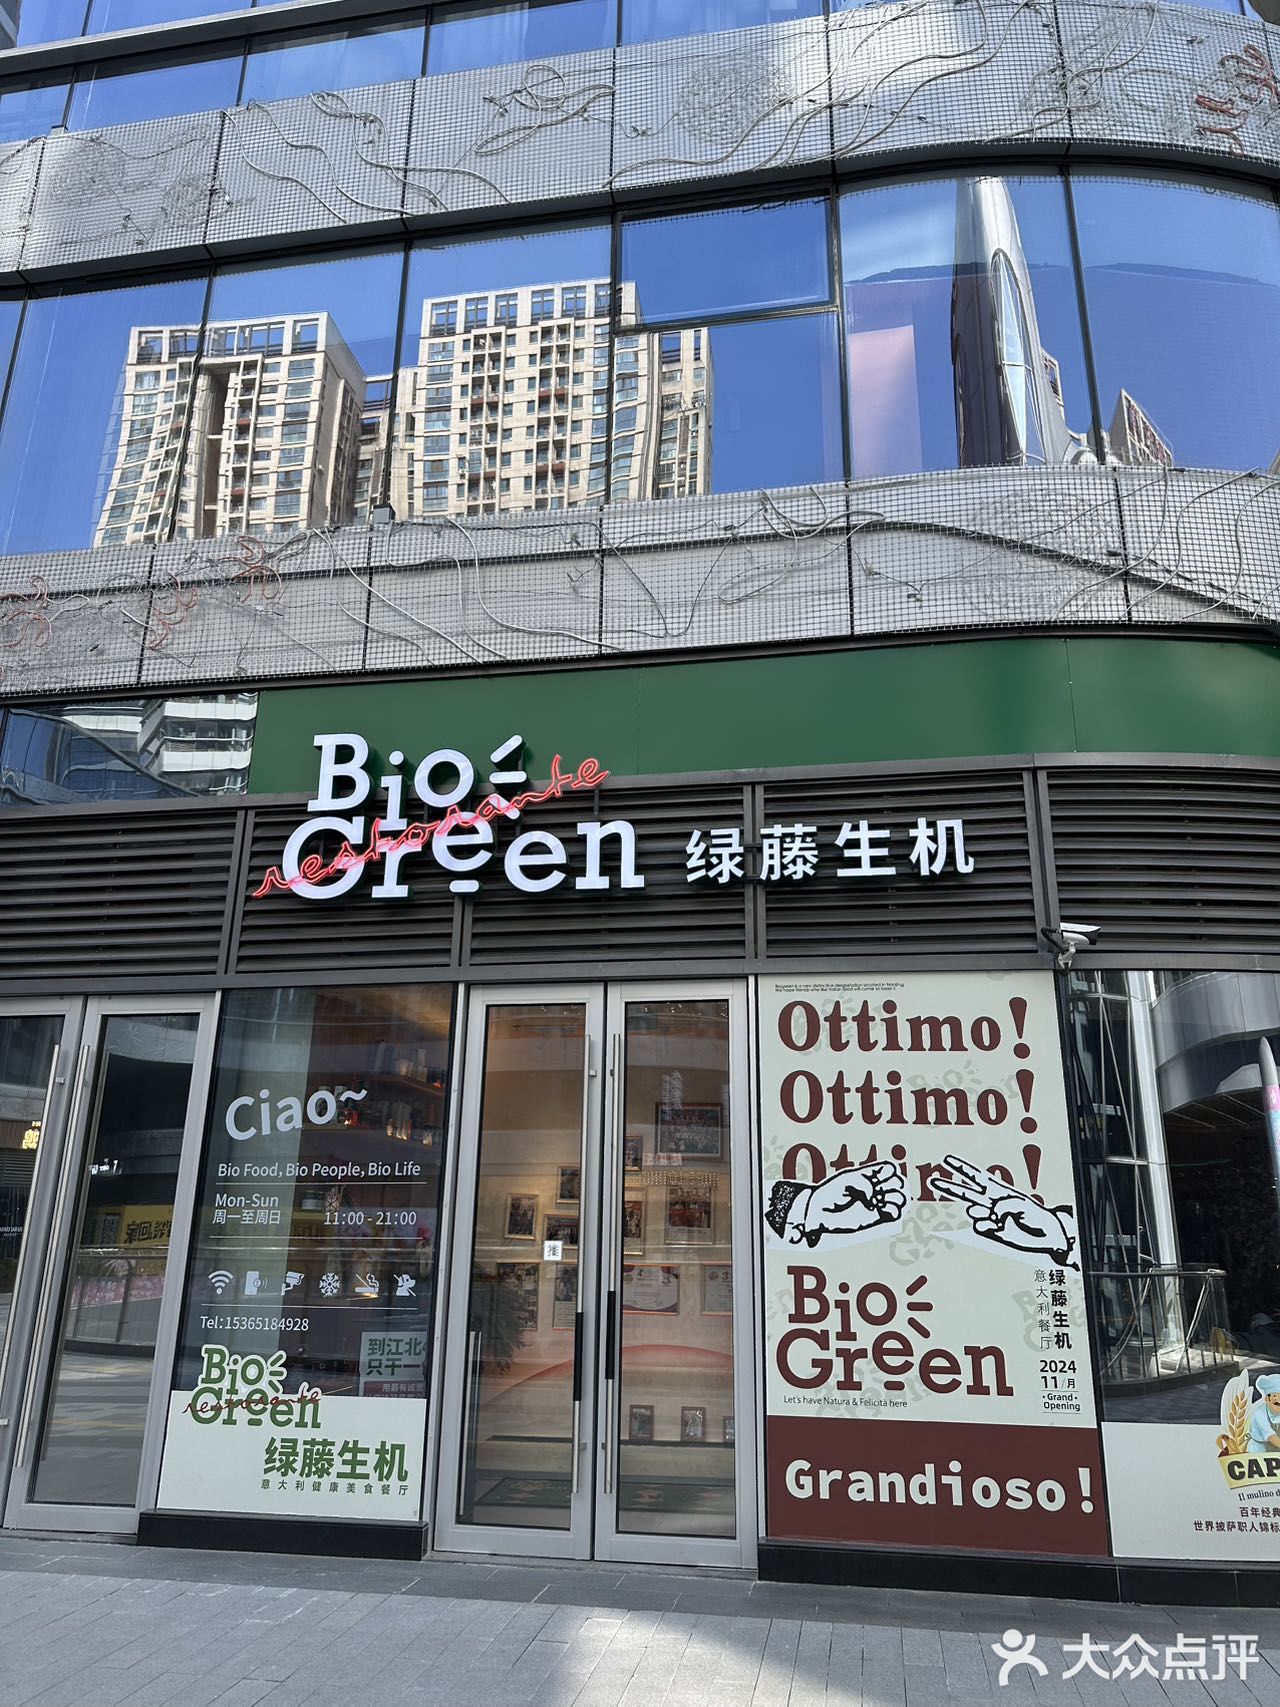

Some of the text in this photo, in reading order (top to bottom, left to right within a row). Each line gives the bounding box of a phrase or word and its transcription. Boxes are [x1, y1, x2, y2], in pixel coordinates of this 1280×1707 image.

[308, 733, 475, 830] Bio
[282, 811, 645, 900] Green
[686, 815, 975, 884] 绿藤生机
[778, 996, 1031, 1059] Ottimo!
[780, 1068, 1038, 1135] Ottimo!
[218, 1163, 240, 1177] Bio
[285, 1163, 308, 1177] Bio
[368, 1162, 391, 1177] Bio
[395, 1161, 421, 1176] Life
[212, 1209, 281, 1225] 周一至周日
[215, 1194, 279, 1208] Mon-Sun
[323, 1211, 364, 1225] 11:00
[375, 1211, 417, 1226] 21:00
[200, 1315, 310, 1331] Tel:15365184928
[787, 1265, 898, 1342] Bio
[1033, 1269, 1053, 1350] 意大利餐厅
[1049, 1269, 1072, 1350] 绿藤生机
[201, 1347, 265, 1395] Bio
[776, 1328, 1015, 1397] Green
[1040, 1360, 1077, 1374] 2024
[191, 1386, 321, 1429] Green
[803, 1395, 822, 1405] have
[823, 1396, 850, 1406] Natura
[852, 1397, 858, 1406] &
[889, 1399, 908, 1408] here
[1043, 1402, 1081, 1412] Opening
[263, 1436, 409, 1482] 绿藤生机
[261, 1478, 409, 1496] 意大利健康美食餐厅
[785, 1459, 1094, 1514] Grandioso!
[1247, 1489, 1275, 1500] mulino
